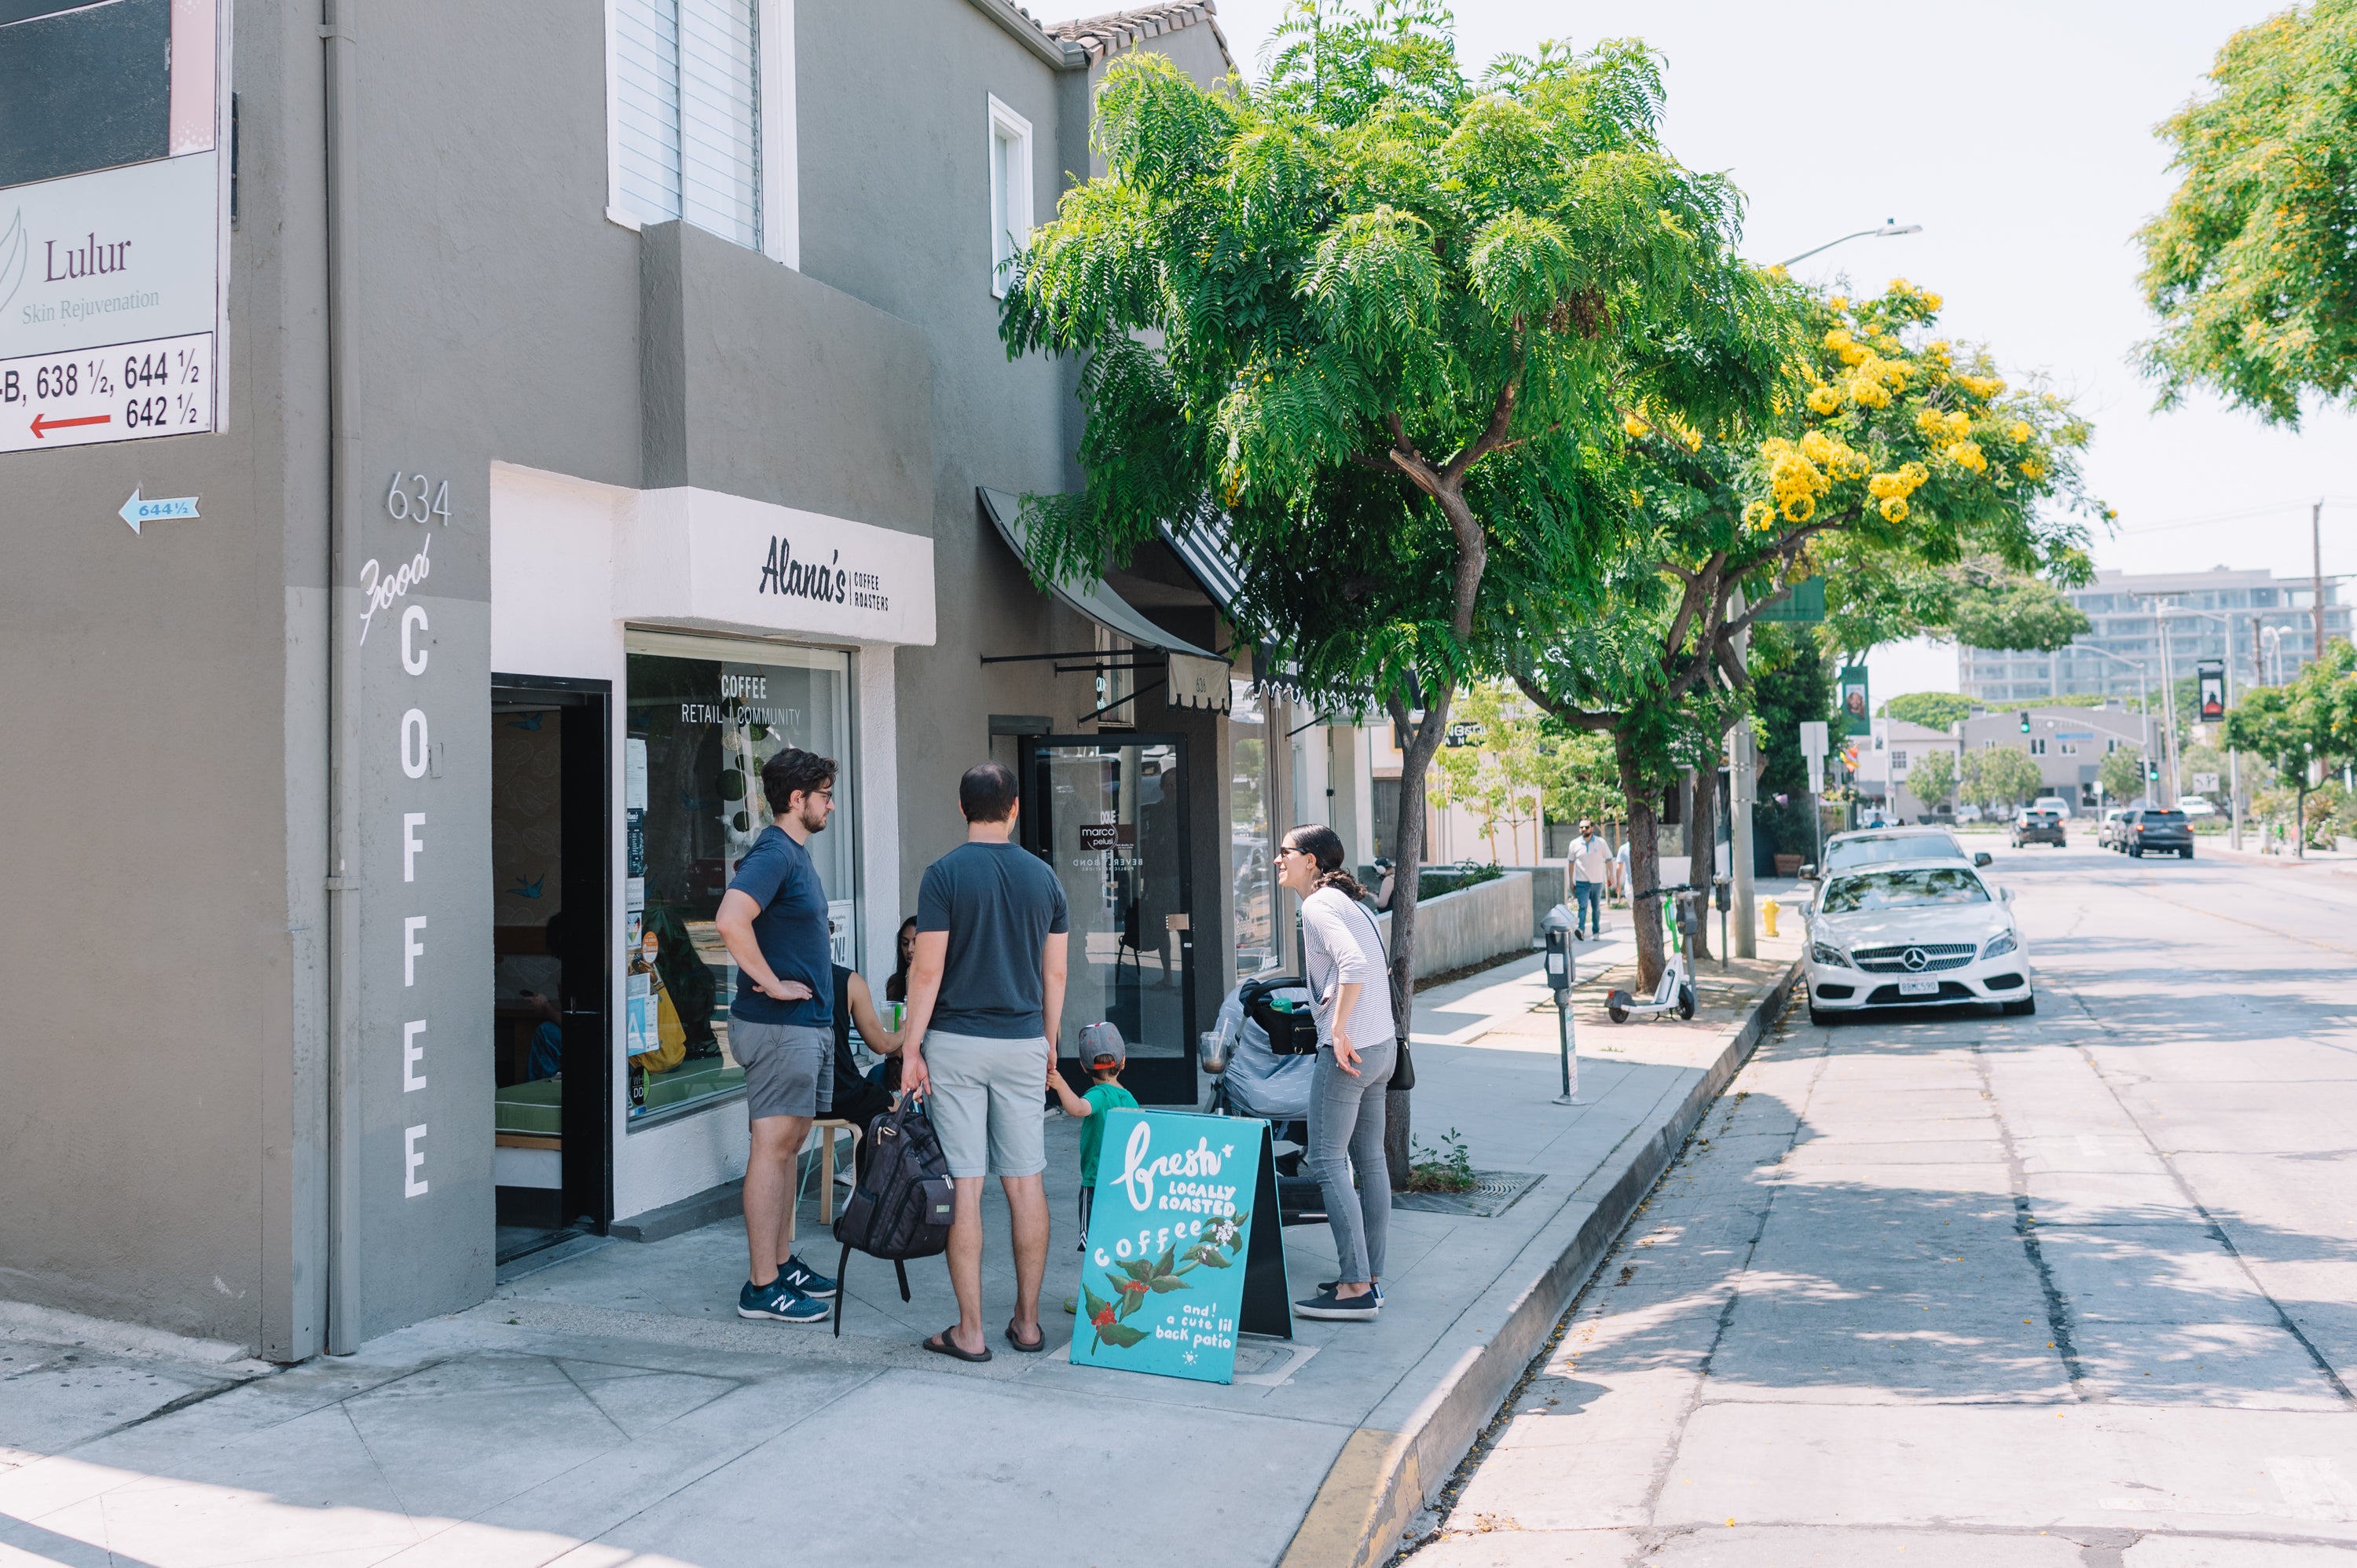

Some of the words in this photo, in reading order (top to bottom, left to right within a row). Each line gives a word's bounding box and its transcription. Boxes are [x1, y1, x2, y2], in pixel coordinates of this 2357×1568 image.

[43, 232, 132, 283] Lulur
[22, 305, 55, 325] Skin
[60, 290, 159, 322] Rejuvenation
[36, 362, 79, 399] 638
[124, 352, 169, 390] 644
[126, 395, 167, 428] 642
[388, 471, 453, 526] 634
[759, 535, 846, 605] Alana's
[854, 571, 880, 592] COFFEE
[854, 592, 889, 612] ROASTERS
[720, 674, 768, 699] COFFEE
[681, 704, 724, 724] RETAIL
[737, 706, 801, 726] COMMUNITY
[1082, 828, 1115, 837] marco
[1093, 837, 1113, 846] pelusi
[401, 604, 429, 1199] COFFEE
[628, 1011, 645, 1050] A
[633, 1086, 644, 1098] DD
[1110, 1120, 1224, 1211] fresh
[1168, 1181, 1237, 1200] LOCALLY
[1158, 1195, 1237, 1218] ROASTED
[786, 1269, 810, 1287] N
[770, 1294, 796, 1313] N
[1166, 1316, 1175, 1325] a
[1181, 1315, 1213, 1331] cute
[1219, 1317, 1233, 1332] lil
[1155, 1325, 1189, 1341] back
[1193, 1332, 1232, 1349] patio
